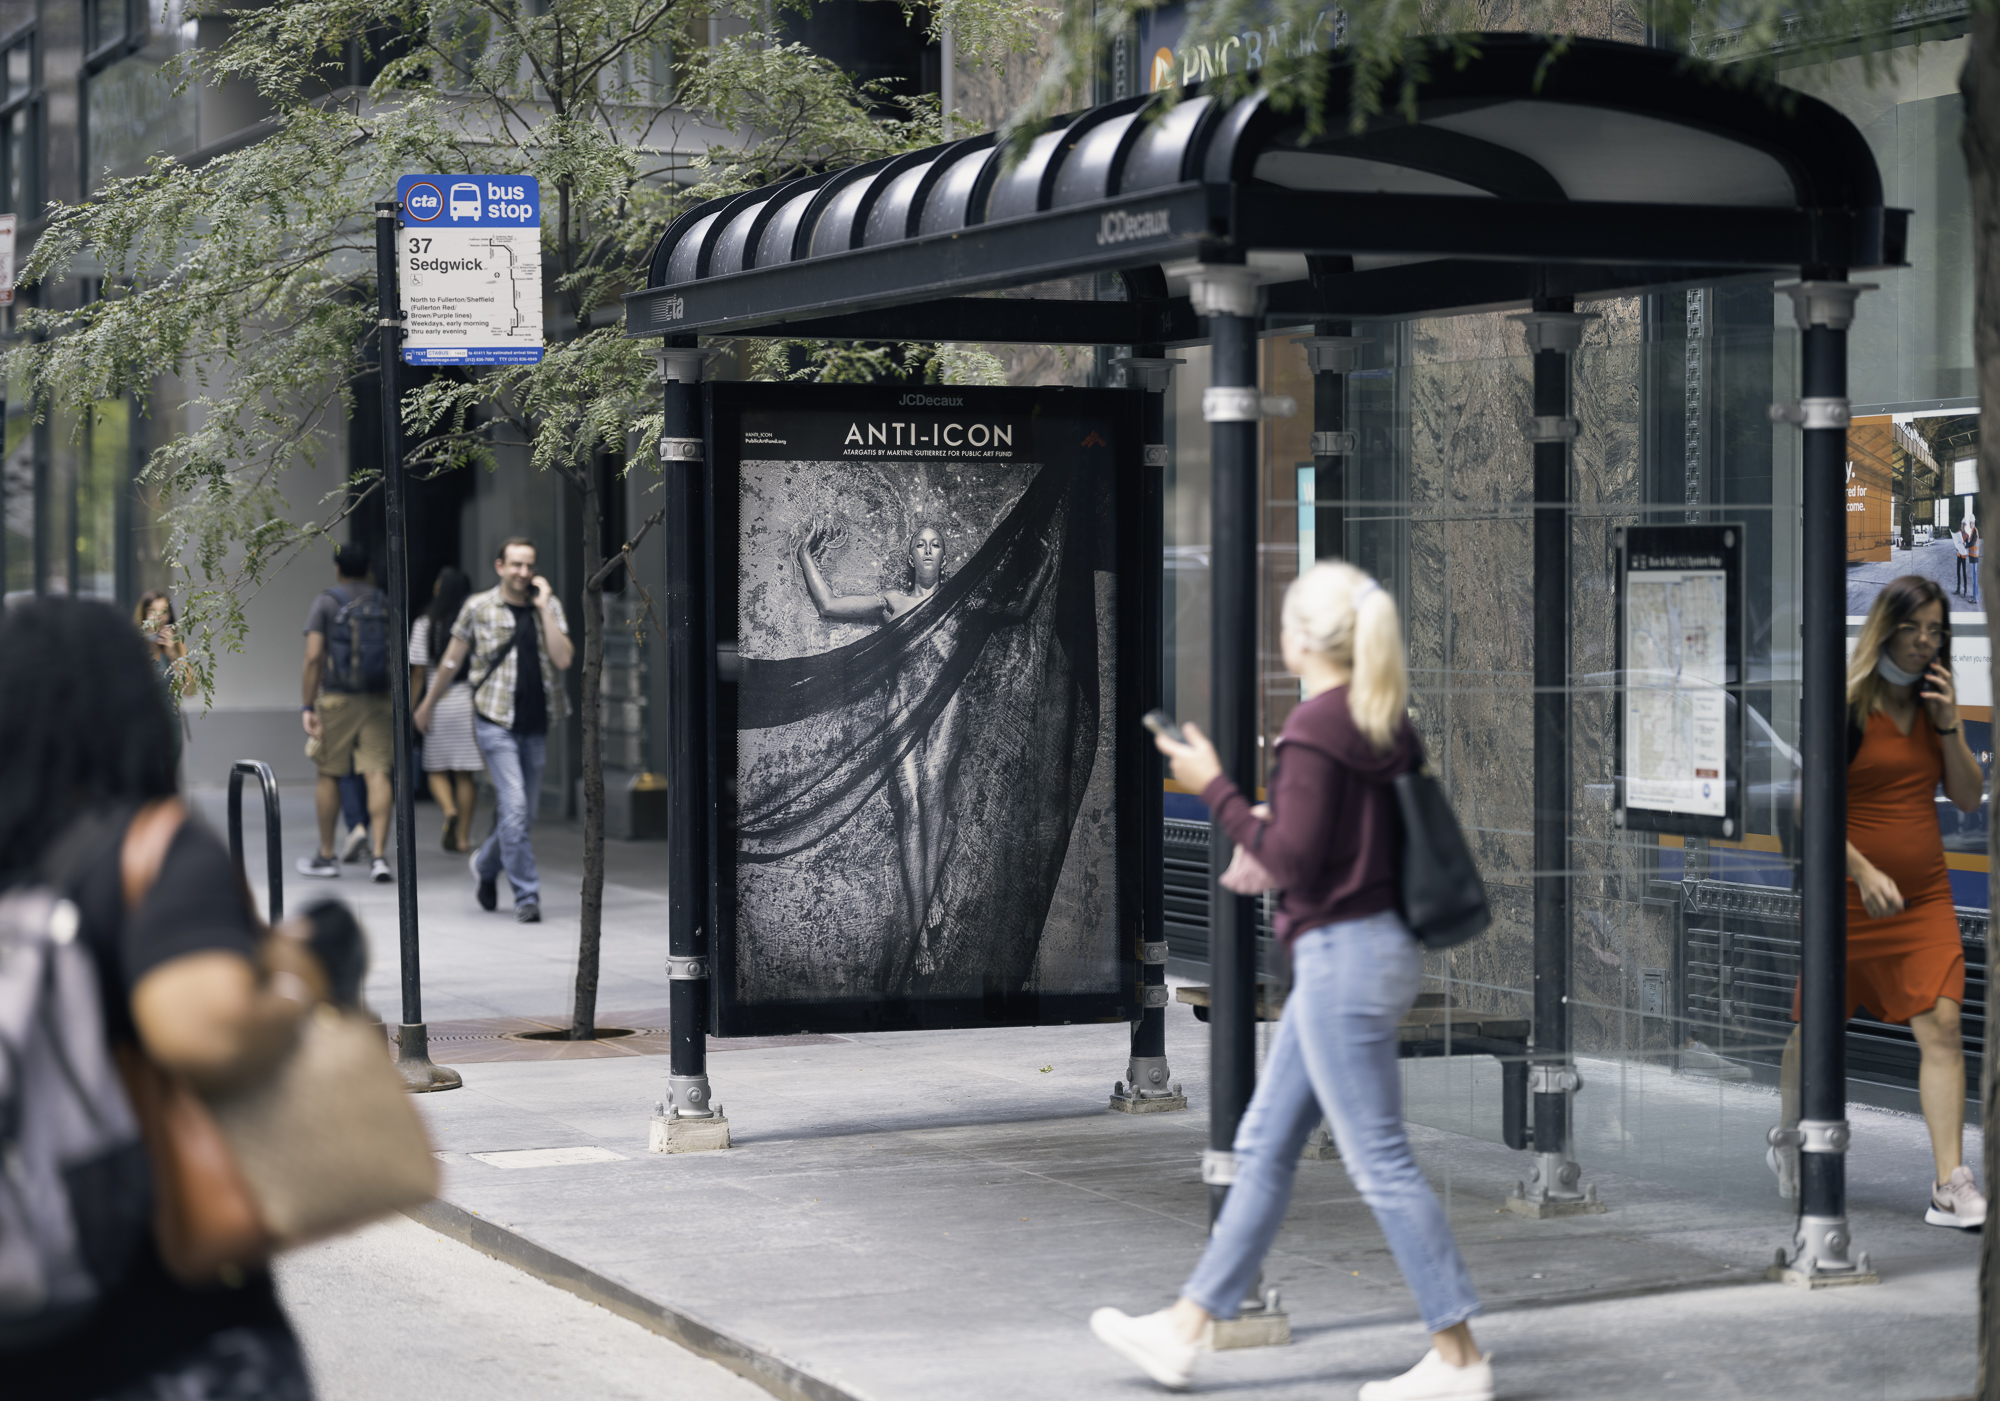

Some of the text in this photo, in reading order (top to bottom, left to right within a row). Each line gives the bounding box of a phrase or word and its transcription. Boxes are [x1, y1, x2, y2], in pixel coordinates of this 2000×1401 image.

[488, 182, 524, 200] bus
[411, 195, 438, 208] cta
[488, 202, 532, 222] stop
[1096, 209, 1170, 246] JCDecaux
[409, 238, 432, 254] 37
[410, 258, 482, 274] Sedgwick
[898, 394, 964, 406] JCDecaux
[844, 422, 1012, 446] ANTI-ICON
[1857, 485, 1867, 497] for
[1846, 502, 1865, 512] come.
[1959, 654, 1972, 662] when
[1973, 656, 1982, 664] you
